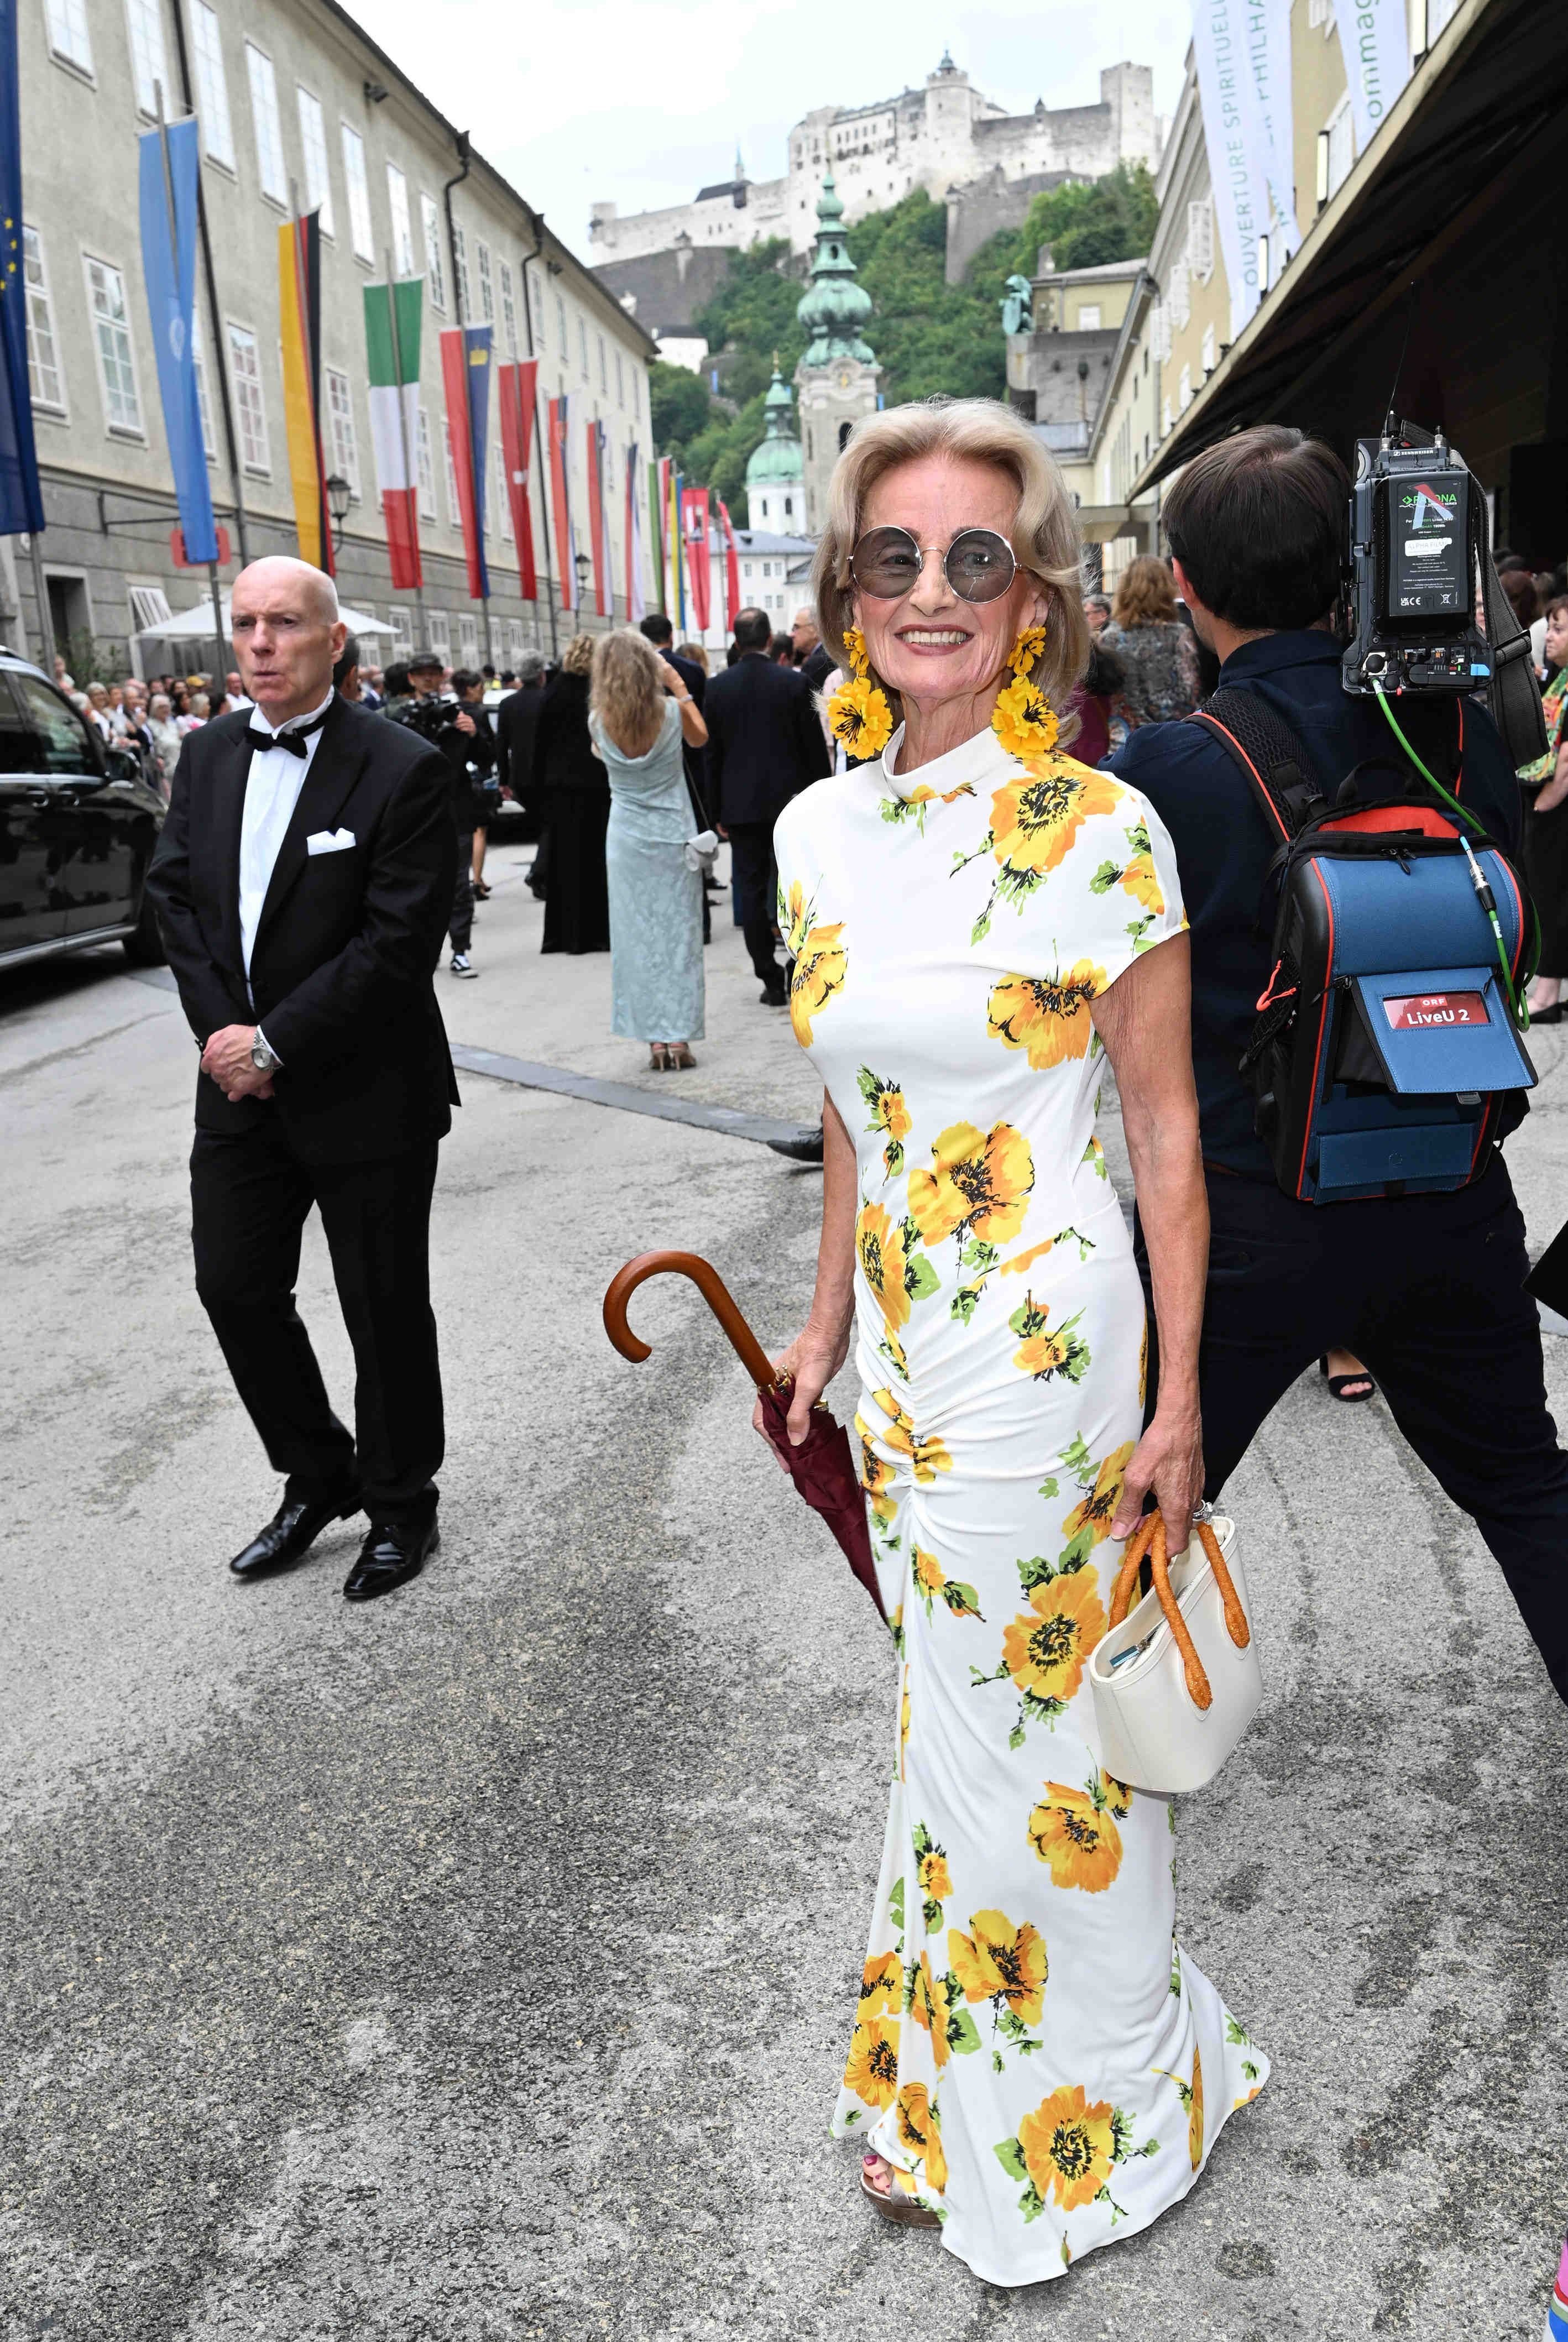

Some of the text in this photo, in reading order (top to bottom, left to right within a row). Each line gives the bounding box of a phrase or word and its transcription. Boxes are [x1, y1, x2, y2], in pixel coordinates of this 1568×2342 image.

[1225, 138, 1258, 286] OUVERTURE
[1413, 494, 1457, 504] PANA
[1422, 998, 1446, 1006] ORF
[1406, 1009, 1471, 1025] LiveU 2
